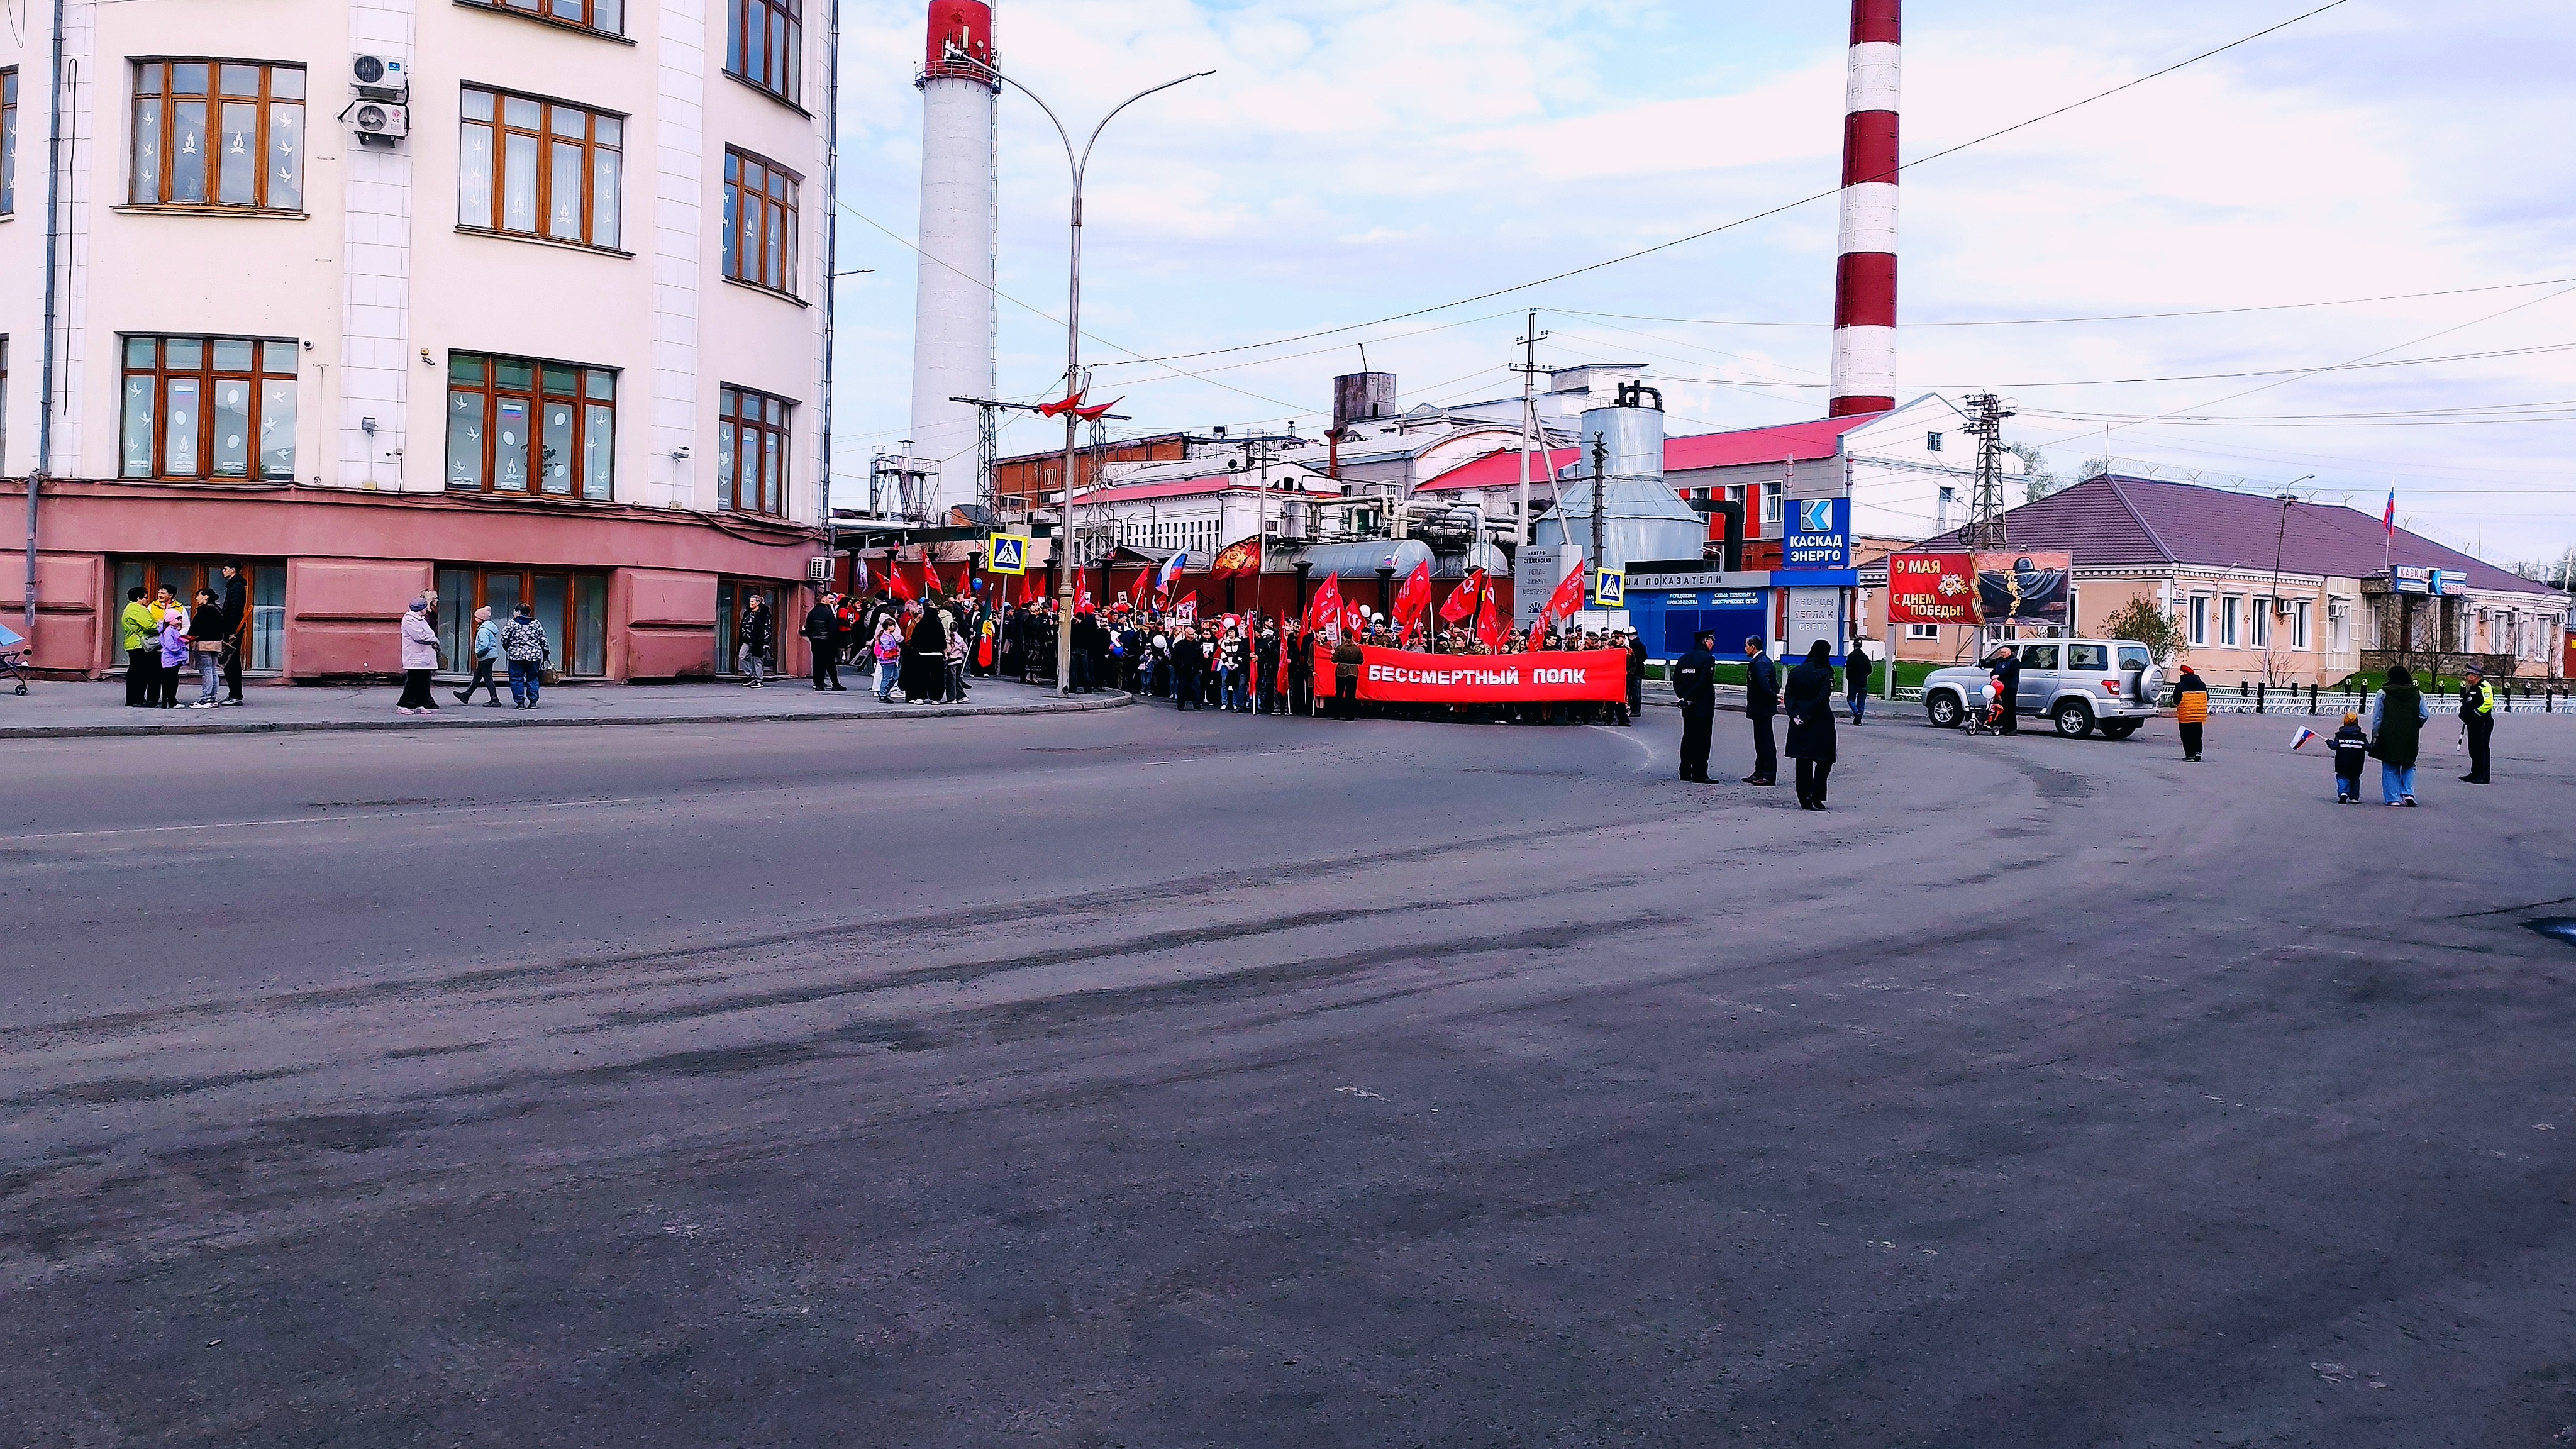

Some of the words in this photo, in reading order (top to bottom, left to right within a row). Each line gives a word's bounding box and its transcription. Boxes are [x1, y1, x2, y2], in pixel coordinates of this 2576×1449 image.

[1044, 468, 1057, 485] 1977
[1790, 535, 1843, 548] КАСКАД
[1790, 550, 1841, 562] ЭНЕРГО
[1896, 560, 1905, 574] 9
[1908, 560, 1940, 574] МАЯ
[1646, 575, 1721, 586] ПОКАЗАТЕЛИ
[2400, 568, 2428, 581] КАСКАД
[1893, 594, 1900, 604] С
[1901, 593, 1935, 606] ДНЕМ
[1910, 604, 1964, 618] ПОБЕДЫ!
[1368, 665, 1519, 685] БЕССМЕРТНЫЙ
[1533, 668, 1587, 684] ПОЛК
